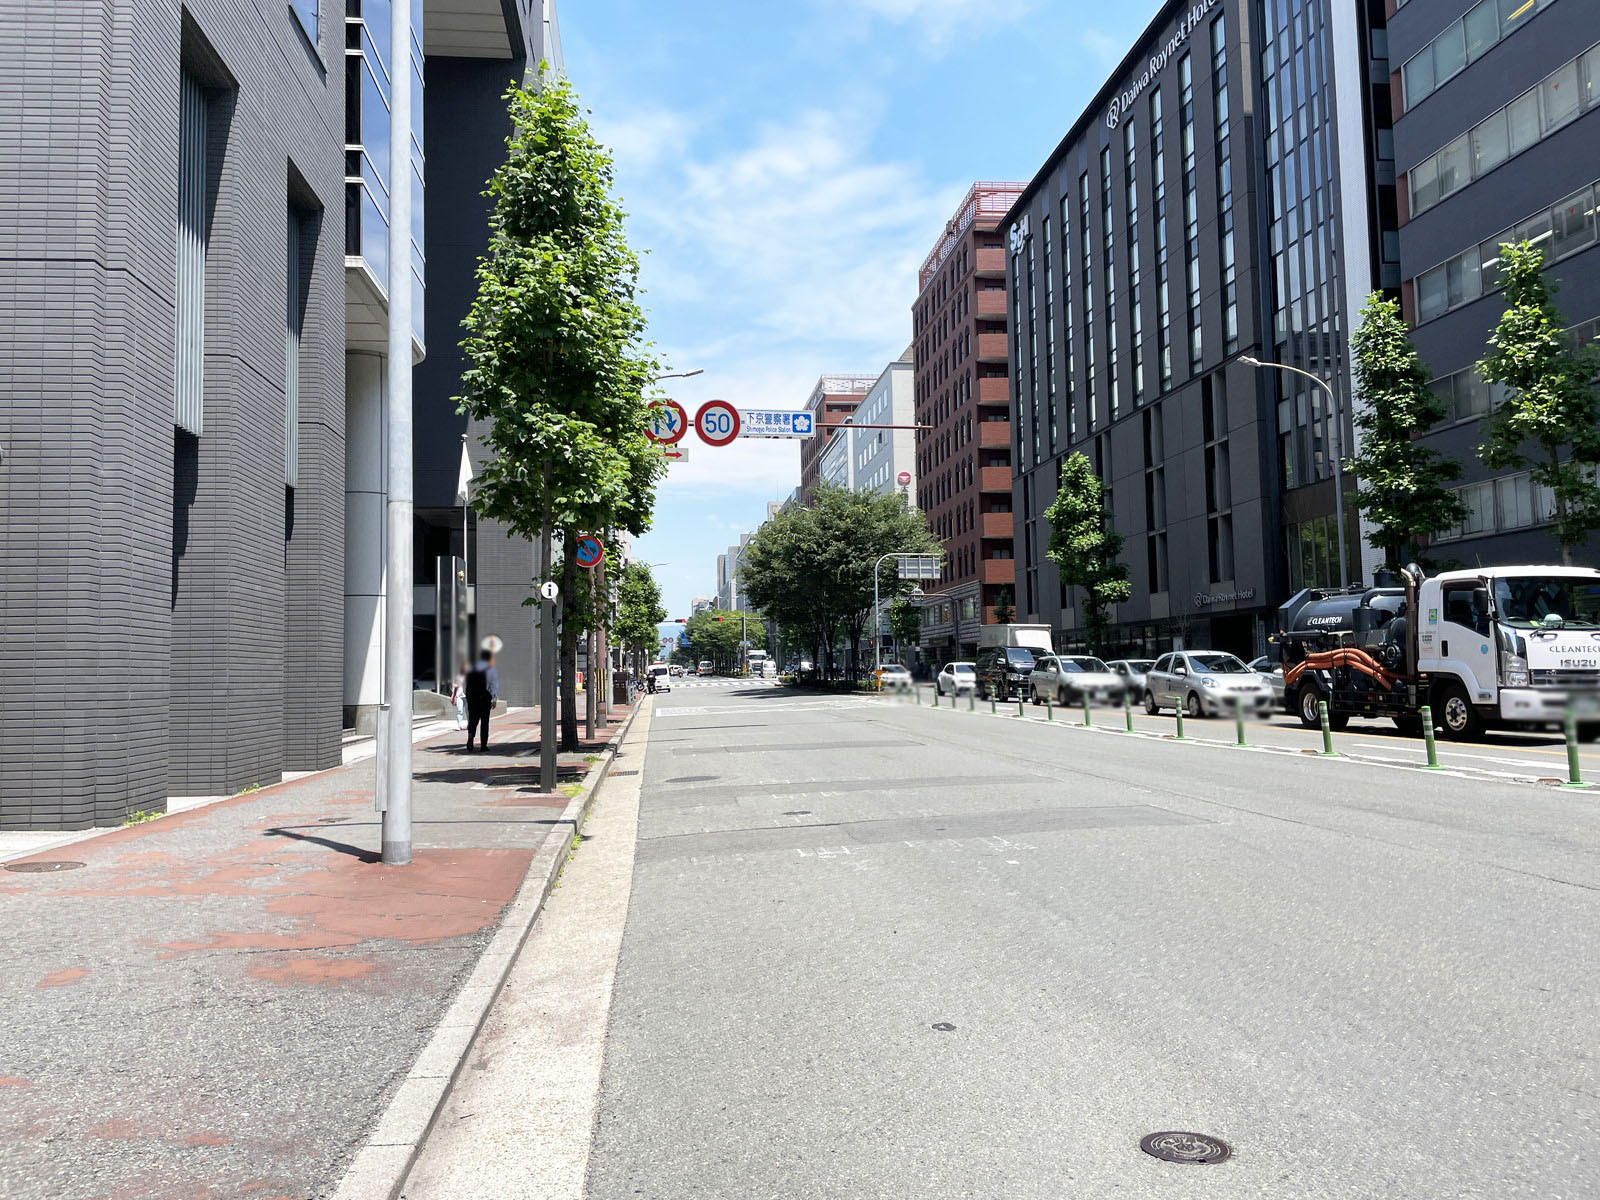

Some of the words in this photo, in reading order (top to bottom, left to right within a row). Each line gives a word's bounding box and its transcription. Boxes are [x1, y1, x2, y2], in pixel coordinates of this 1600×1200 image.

[1121, 71, 1150, 112] Daiwa
[1149, 21, 1187, 79] Roynet
[705, 413, 730, 434] 50
[746, 412, 791, 425] 下京警察署
[1237, 588, 1253, 600] Hotel
[1312, 616, 1343, 625] CLEANTECH
[1560, 659, 1597, 667] ISUZU
